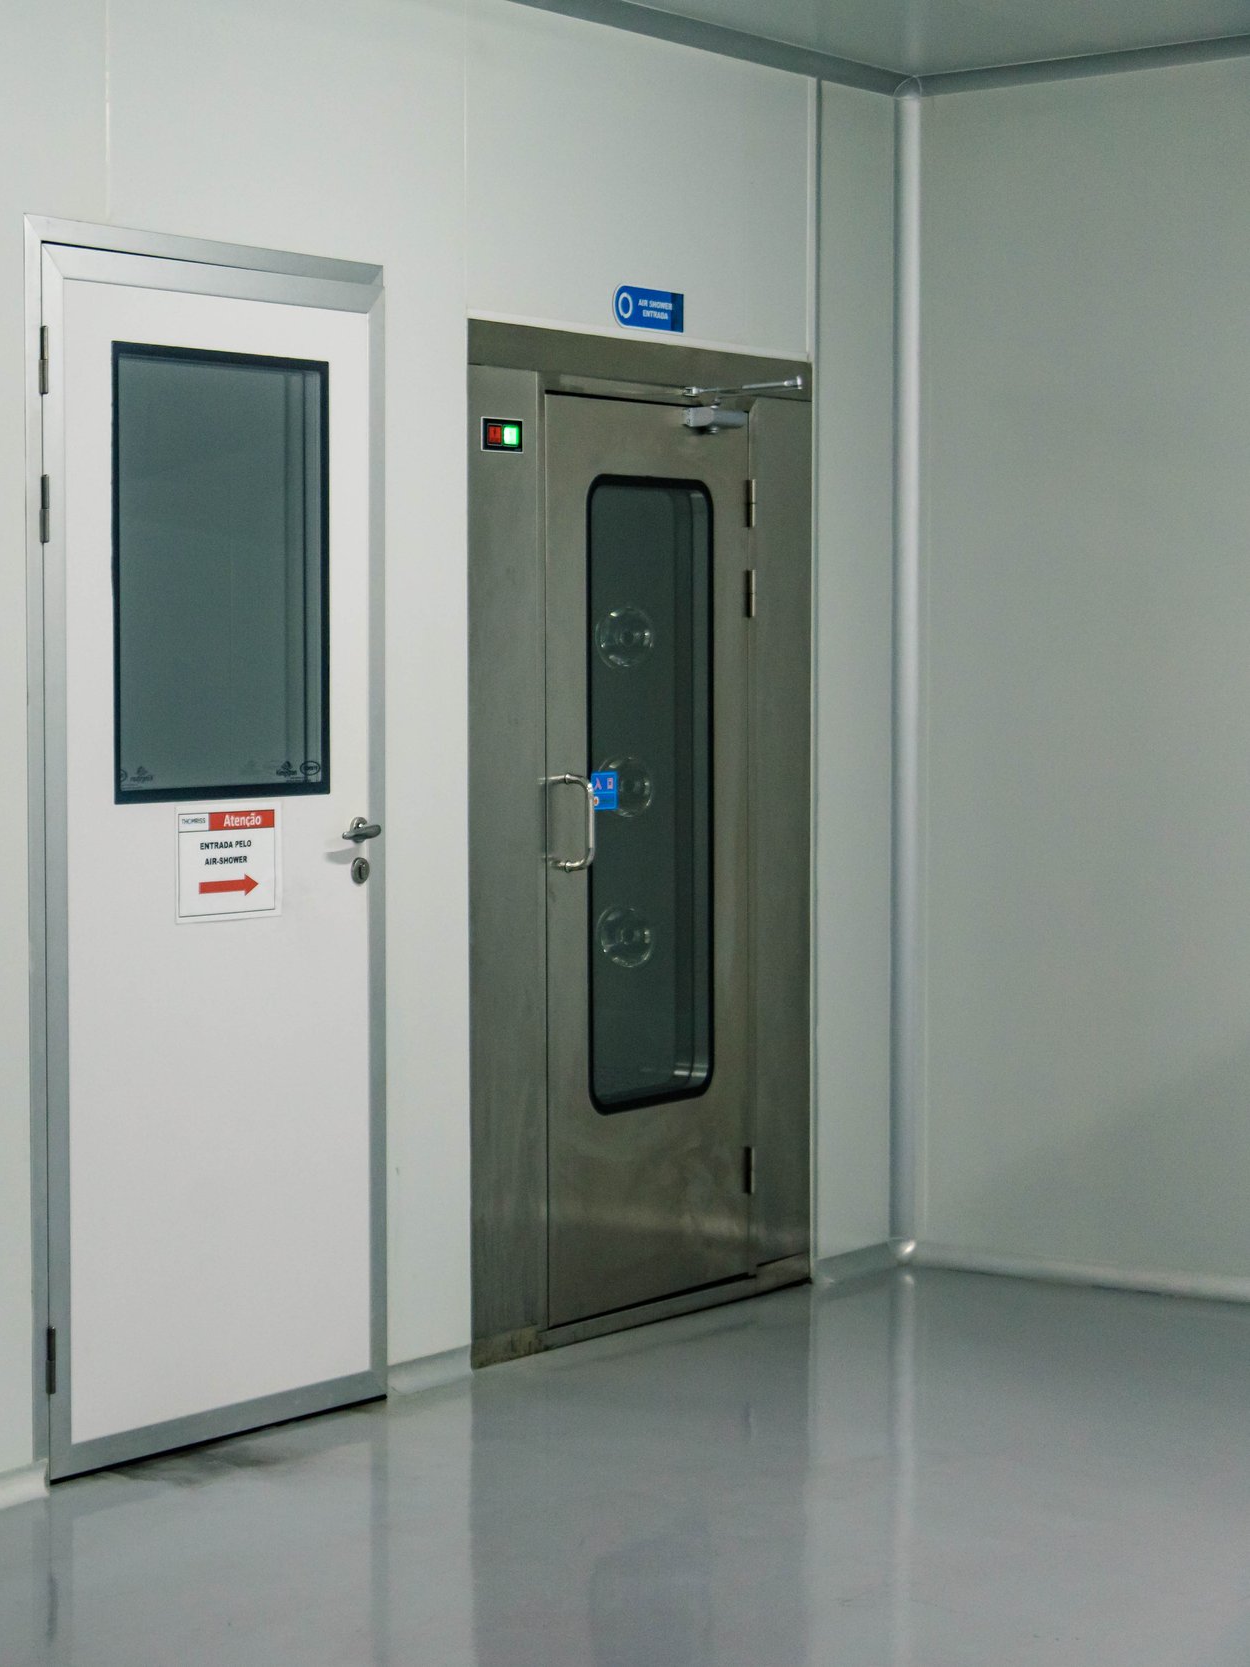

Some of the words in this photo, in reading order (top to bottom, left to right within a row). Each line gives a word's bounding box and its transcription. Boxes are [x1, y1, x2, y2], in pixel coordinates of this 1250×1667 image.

[638, 299, 648, 307] AIR
[649, 301, 673, 310] SHOWER
[642, 310, 668, 320] ENTRADA
[223, 813, 262, 827] Atenção
[200, 841, 233, 850] ENTRADA
[235, 839, 252, 848] PELO
[205, 855, 247, 865] AIR-SHOWER
